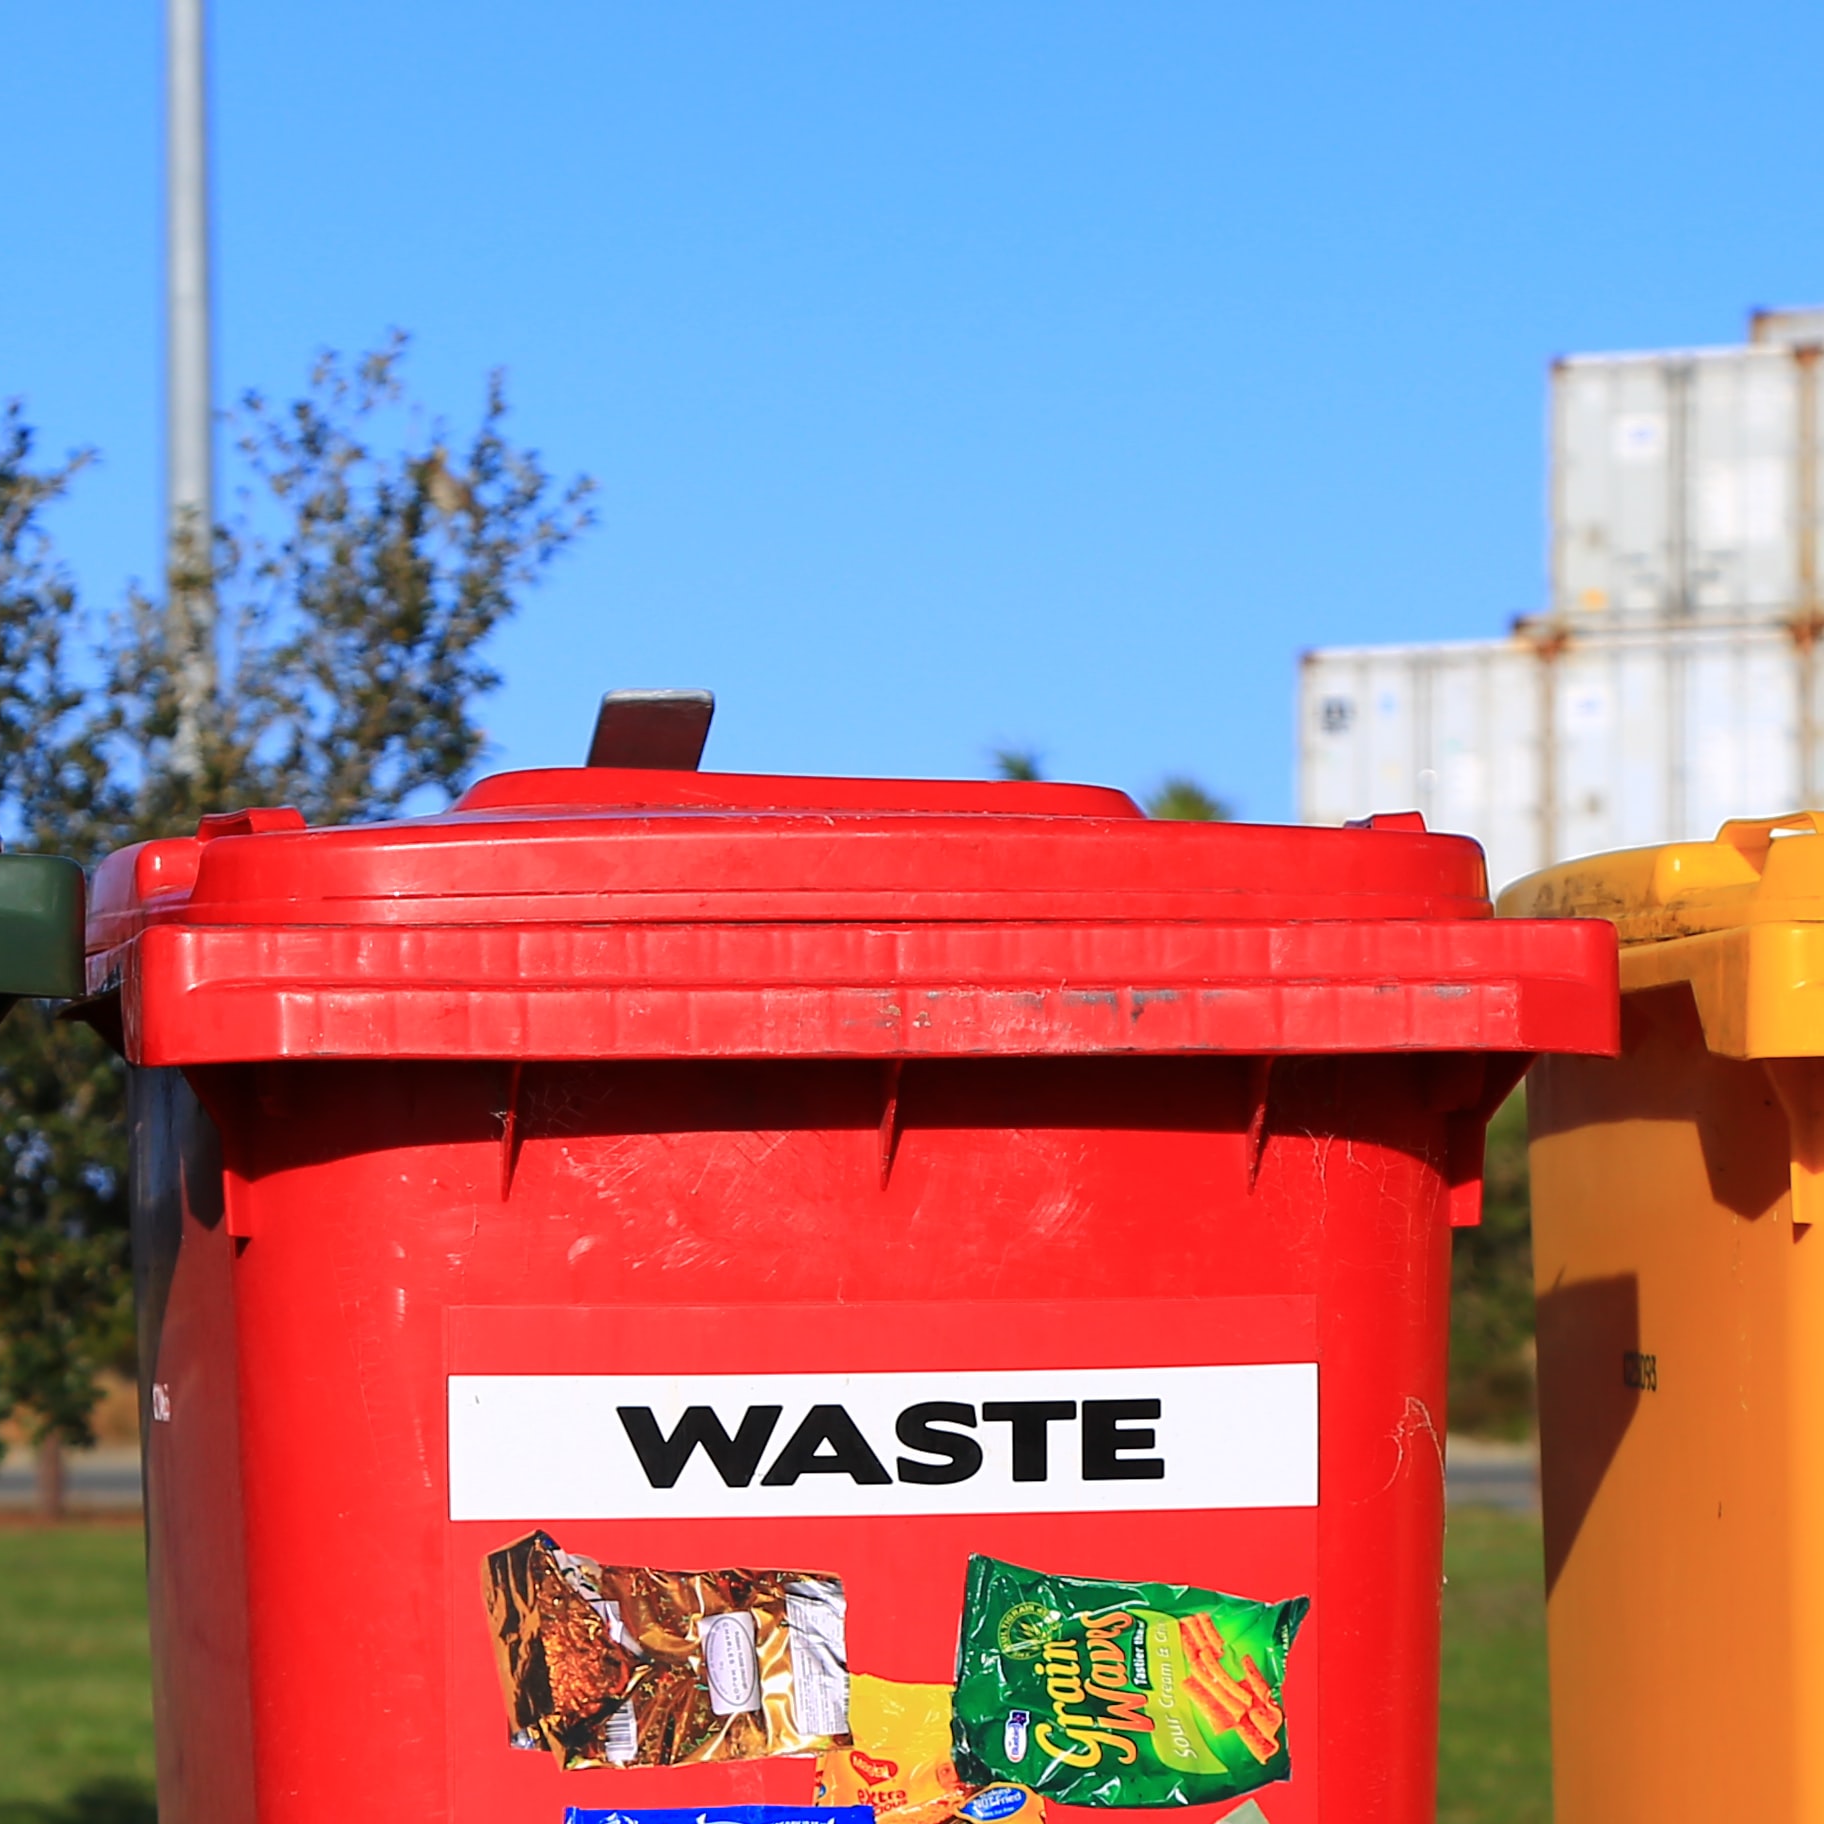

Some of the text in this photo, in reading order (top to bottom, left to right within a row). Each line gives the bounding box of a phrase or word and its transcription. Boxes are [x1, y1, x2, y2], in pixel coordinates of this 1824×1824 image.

[616, 1398, 1166, 1489] WASTE
[1080, 1611, 1156, 1733] Waves
[1133, 1643, 1149, 1687] Tastier
[1159, 1661, 1177, 1709] Cream
[1034, 1638, 1138, 1769] Grain
[1166, 1712, 1199, 1760] Sour
